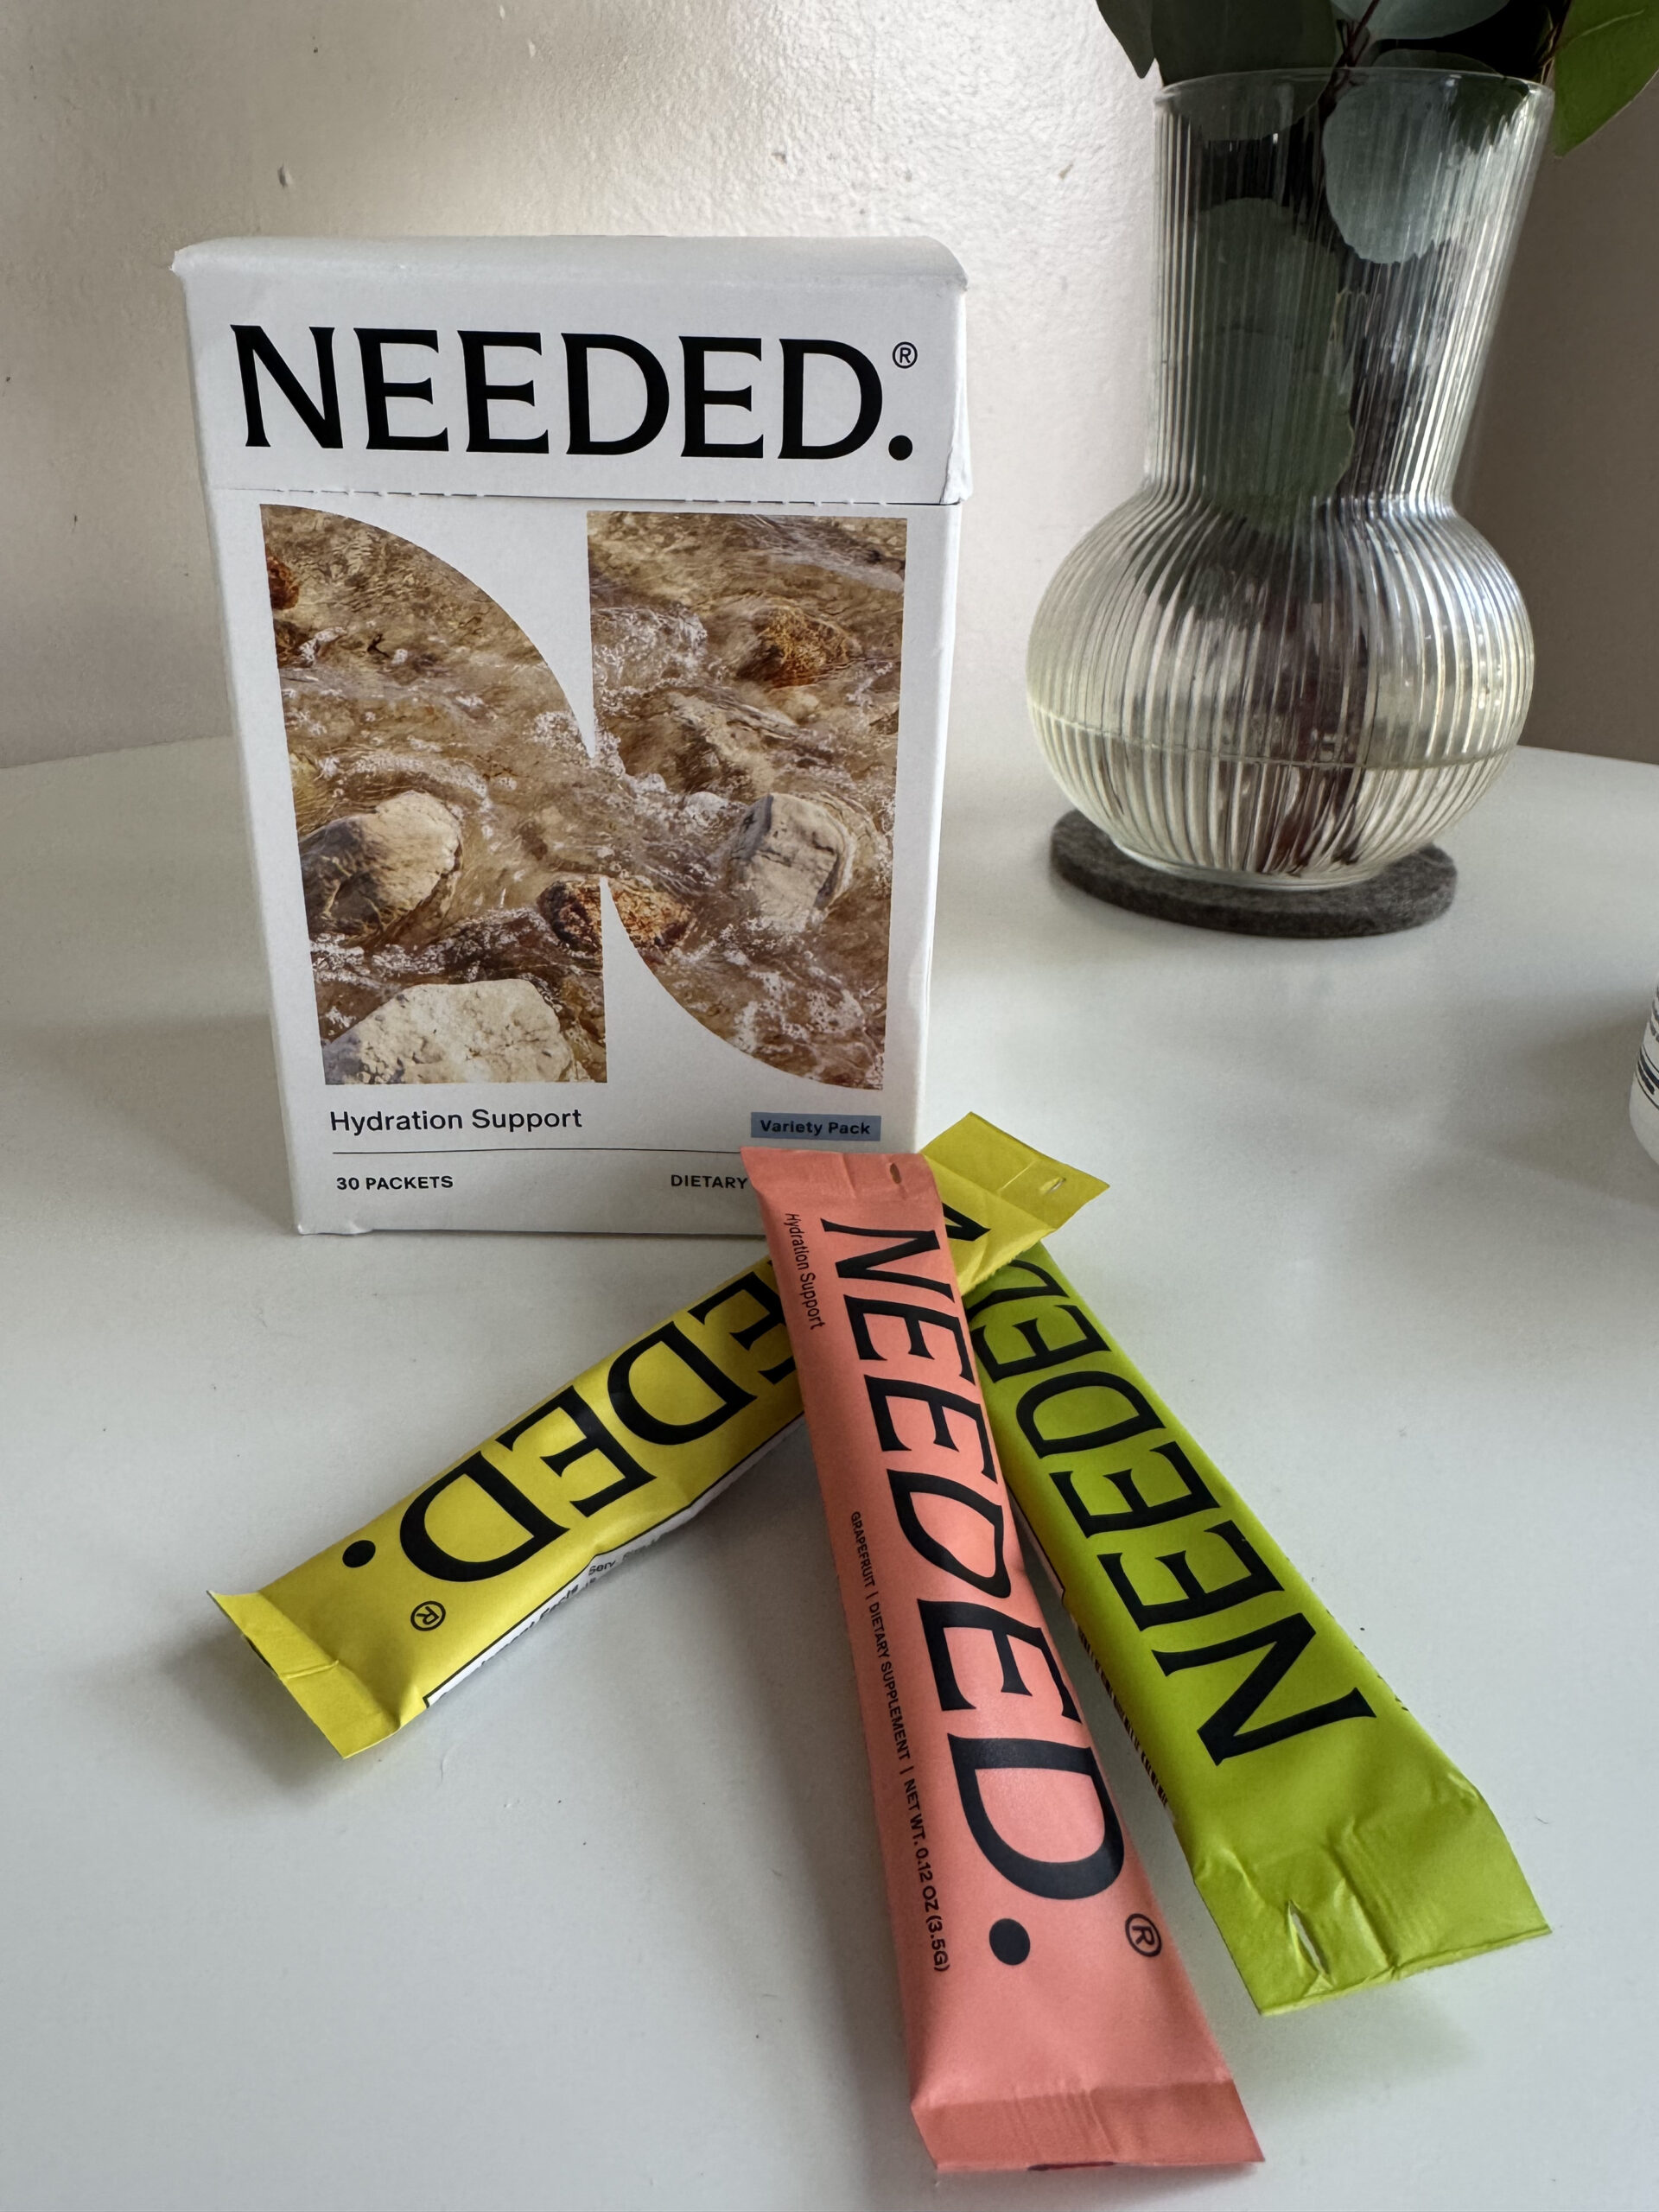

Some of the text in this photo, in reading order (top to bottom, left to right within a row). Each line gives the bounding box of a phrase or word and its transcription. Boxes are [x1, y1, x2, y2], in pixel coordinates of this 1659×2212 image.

[330, 1109, 582, 1135] Hydration Support
[760, 1119, 871, 1136] Variety Pack
[336, 1175, 454, 1190] 30 PACKETS
[671, 1174, 748, 1189] DIETARY
[784, 1213, 825, 1331] Hydration Support
[851, 1511, 875, 1587] GRAPEFRUIT
[869, 1602, 890, 1658] DIETARY
[881, 1661, 910, 1760] SUPPLEMENT
[904, 1778, 920, 1811] NET
[910, 1813, 925, 1846] WT.
[915, 1847, 933, 1883] 0.12
[922, 1885, 939, 1912] OZ
[925, 1915, 950, 1972] (3.5G)
